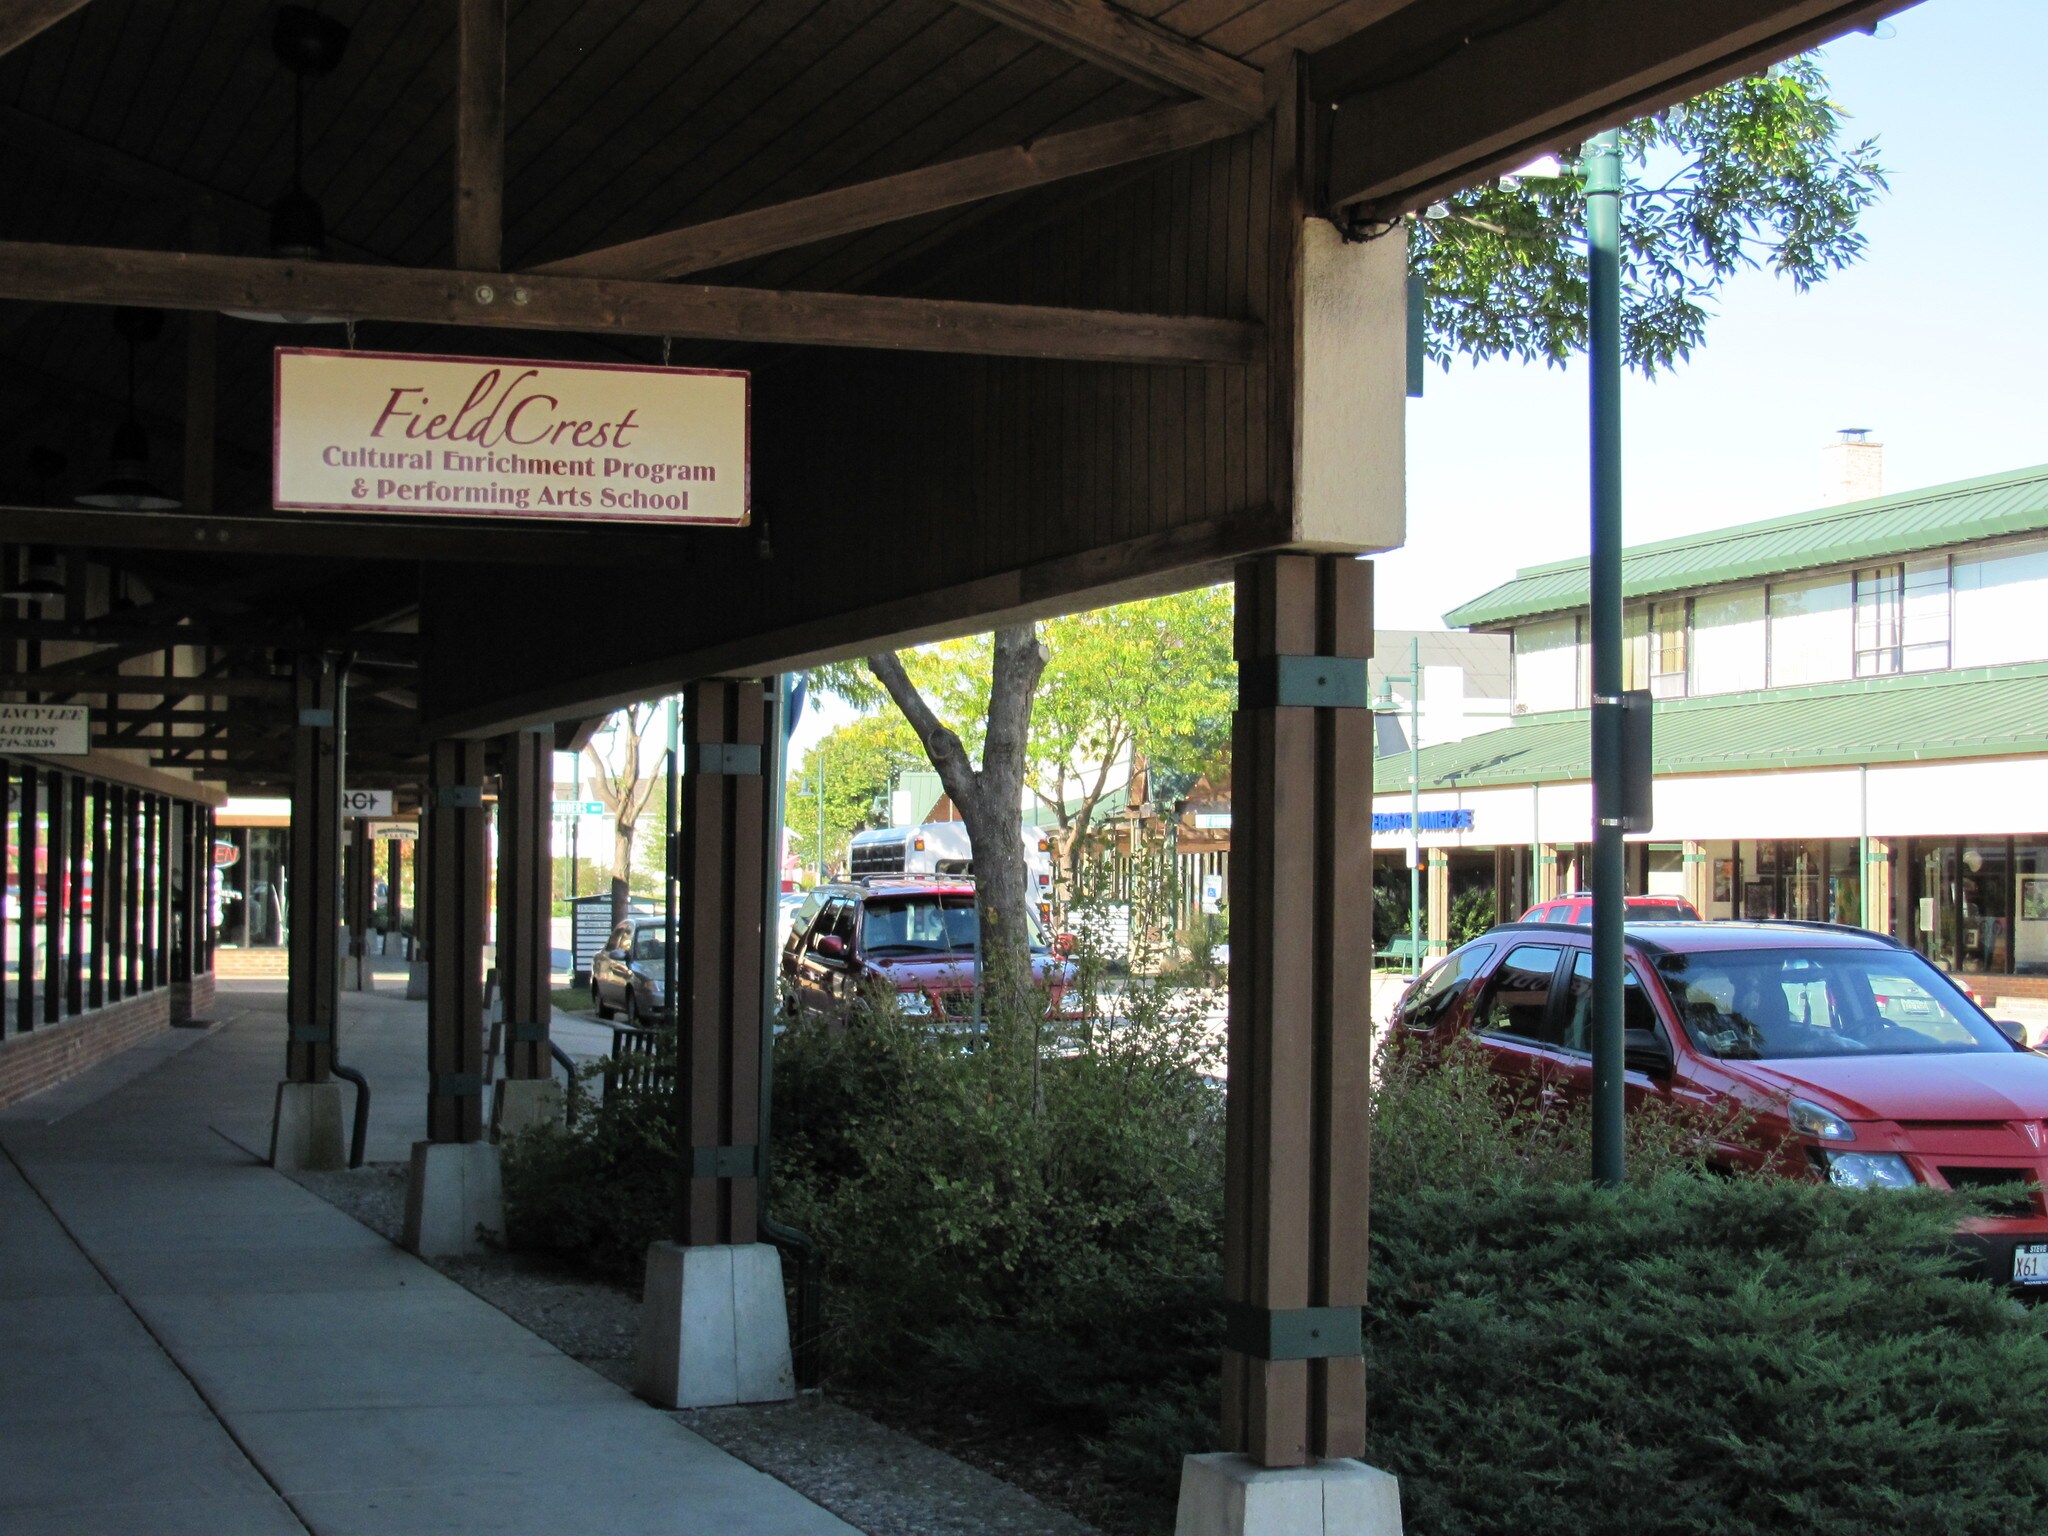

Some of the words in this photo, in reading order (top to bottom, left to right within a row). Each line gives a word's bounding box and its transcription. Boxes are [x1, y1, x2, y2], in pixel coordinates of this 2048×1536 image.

[322, 445, 433, 471] Cultural
[443, 450, 596, 478] Enrichment
[603, 457, 716, 483] Program
[351, 478, 368, 498] &
[377, 478, 530, 509] Performing
[537, 485, 593, 507] Arts
[600, 487, 689, 511] School
[553, 802, 587, 814] UNDERS
[214, 846, 239, 863] EN
